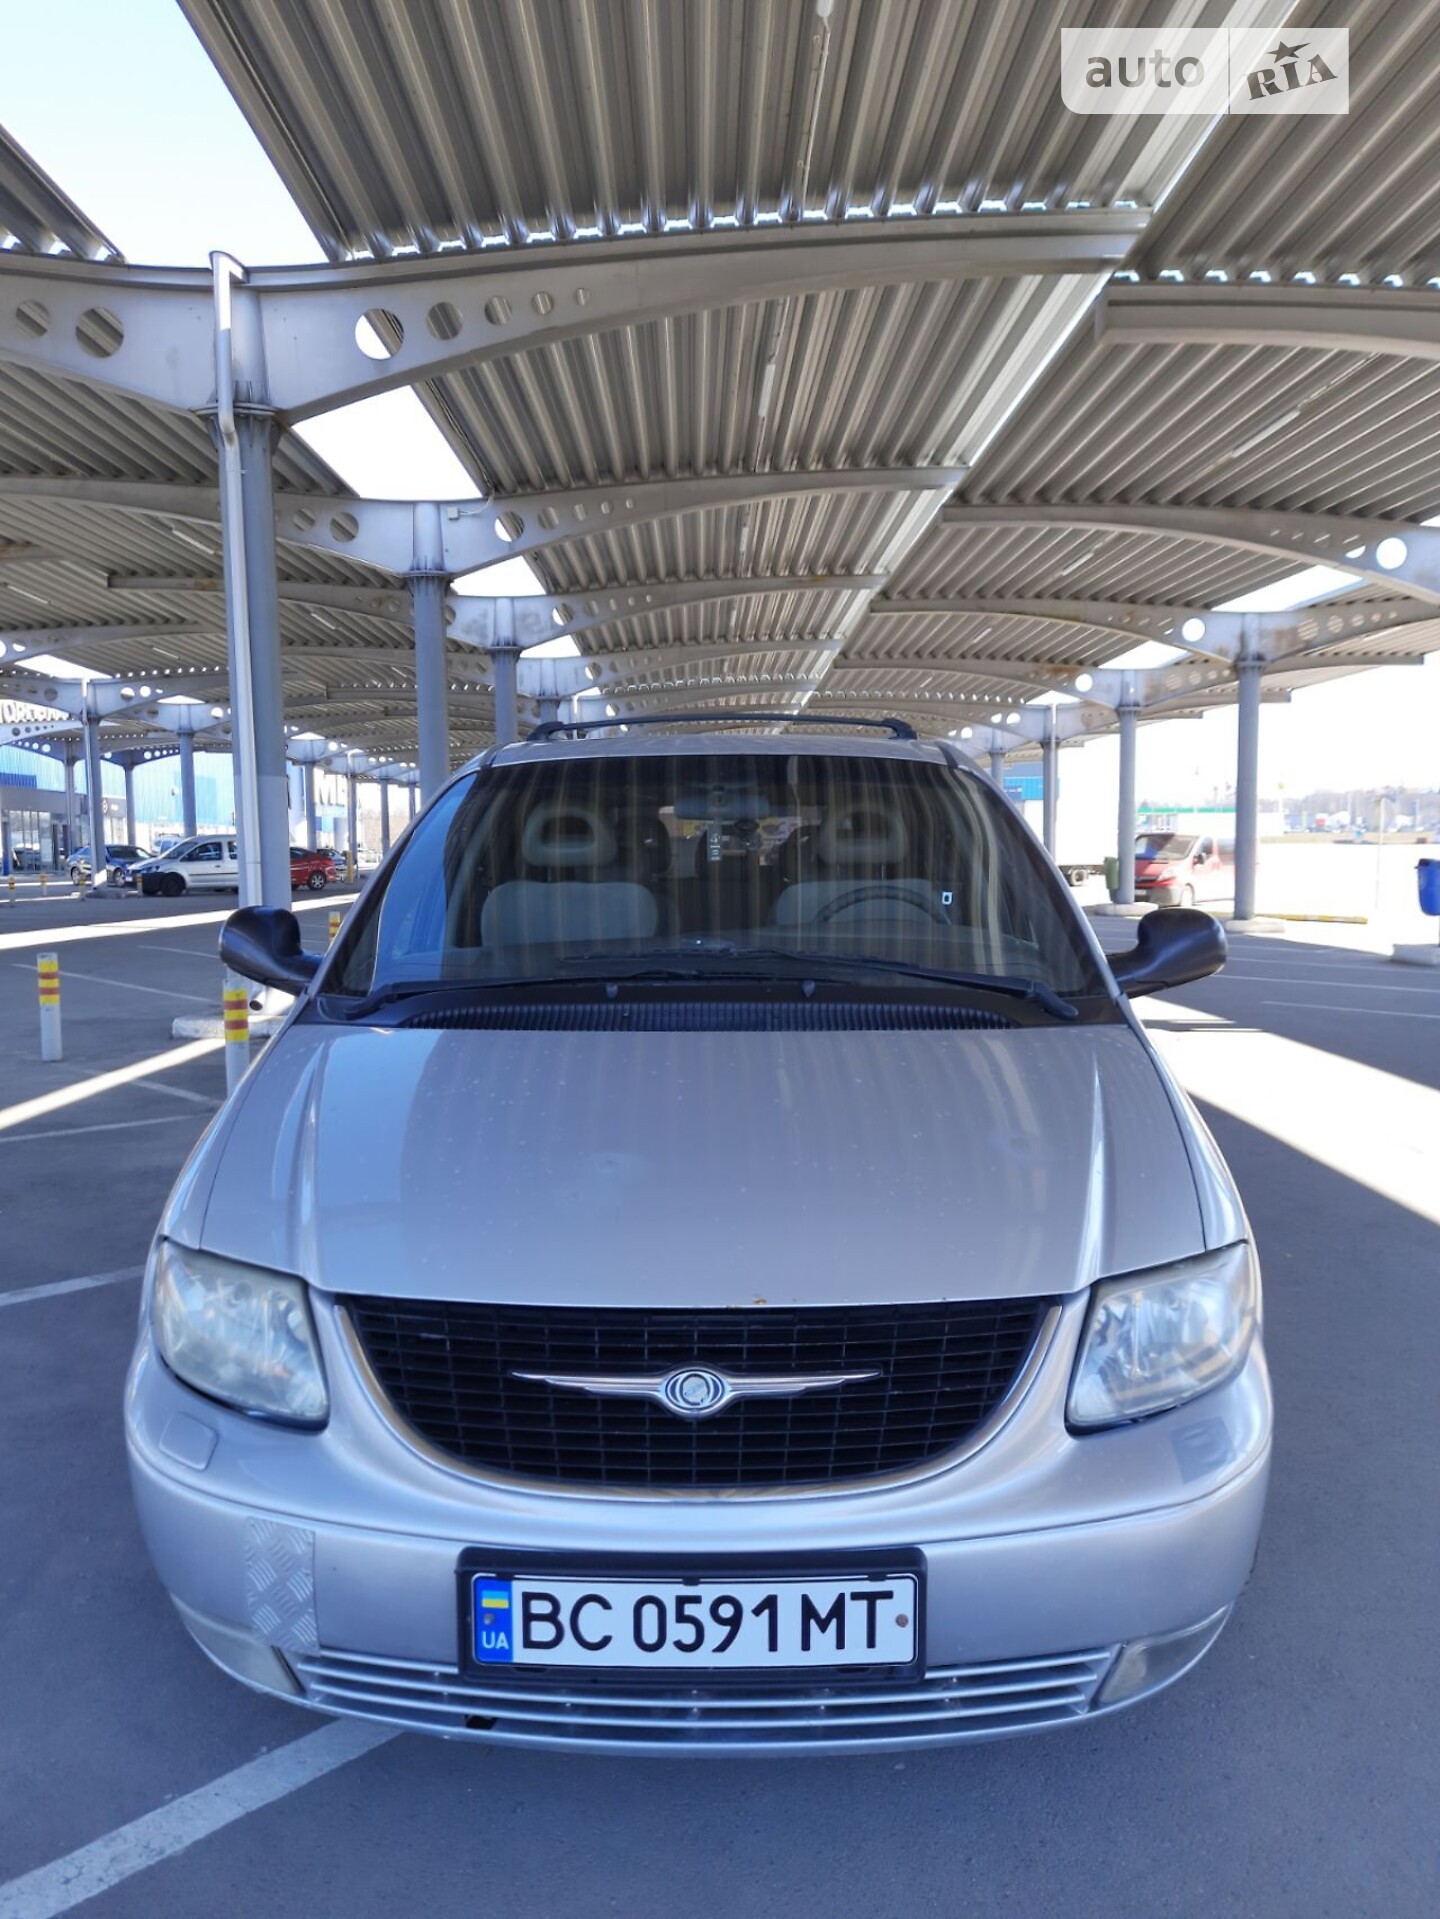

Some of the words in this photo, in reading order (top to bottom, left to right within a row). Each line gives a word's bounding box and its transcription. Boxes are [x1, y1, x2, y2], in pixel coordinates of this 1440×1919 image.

[481, 1630, 509, 1650] UA
[522, 1591, 613, 1651] BC
[632, 1593, 778, 1653] 0591
[801, 1590, 894, 1652] MT
